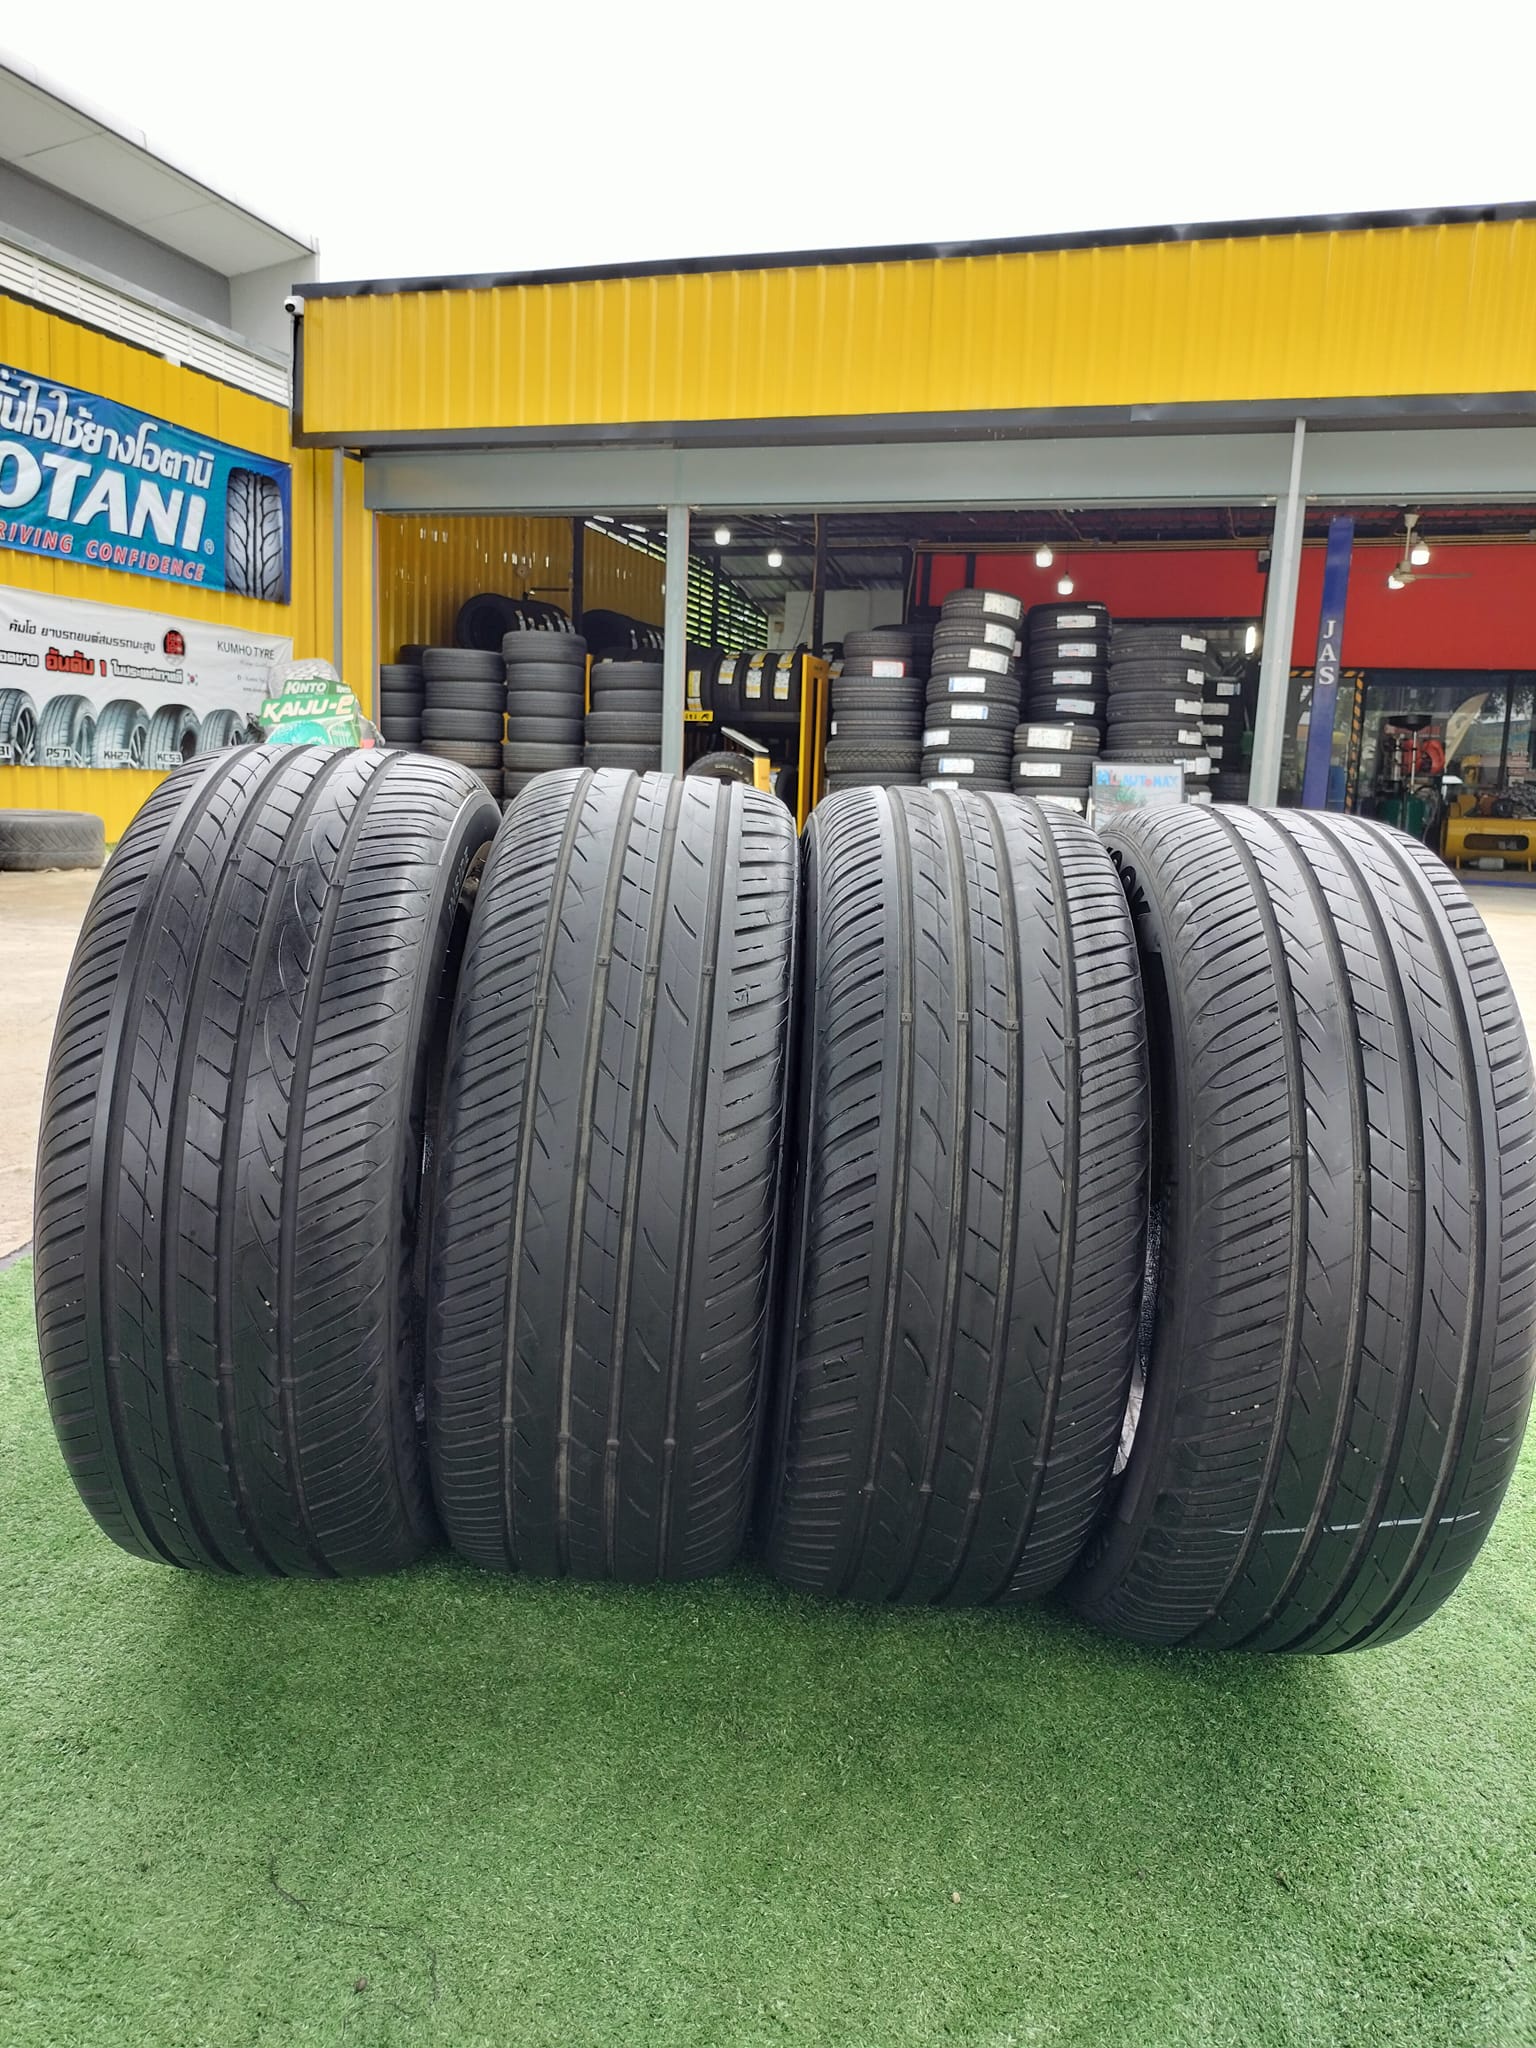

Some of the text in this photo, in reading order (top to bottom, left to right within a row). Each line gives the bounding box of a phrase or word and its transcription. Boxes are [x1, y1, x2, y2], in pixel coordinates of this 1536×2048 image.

[0, 369, 215, 489] ั่นใจใช้ยางโอตานิ
[86, 540, 205, 581] CONFIDENCE
[45, 647, 95, 675] อันดับ
[216, 640, 275, 661] KUMHO TYRE
[1318, 620, 1337, 685] JAS
[284, 680, 327, 695] KINTO
[103, 750, 131, 760] KH27
[157, 753, 182, 763] KC53
